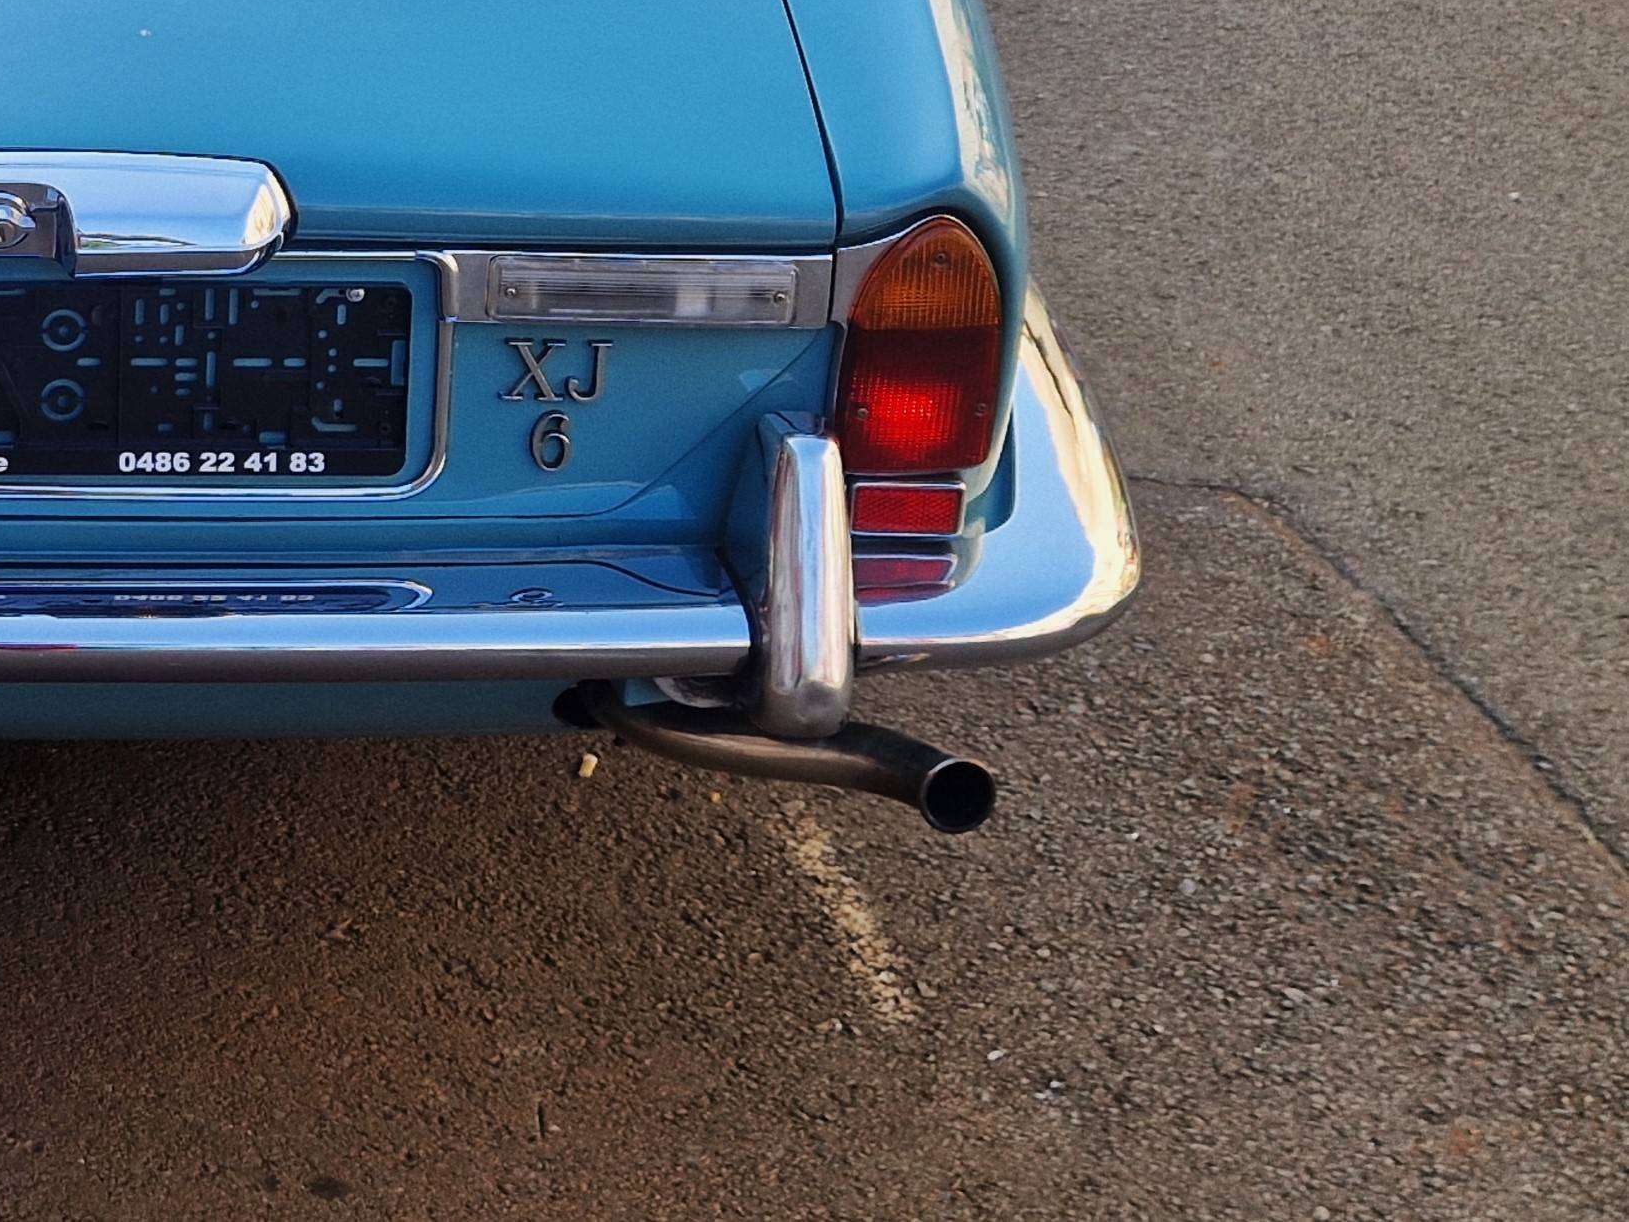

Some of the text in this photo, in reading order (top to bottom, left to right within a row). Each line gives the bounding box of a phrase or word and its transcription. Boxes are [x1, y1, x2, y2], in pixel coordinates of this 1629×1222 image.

[500, 338, 613, 402] XJ
[118, 452, 325, 473] 0486 22 41 83
[531, 410, 573, 472] 6
